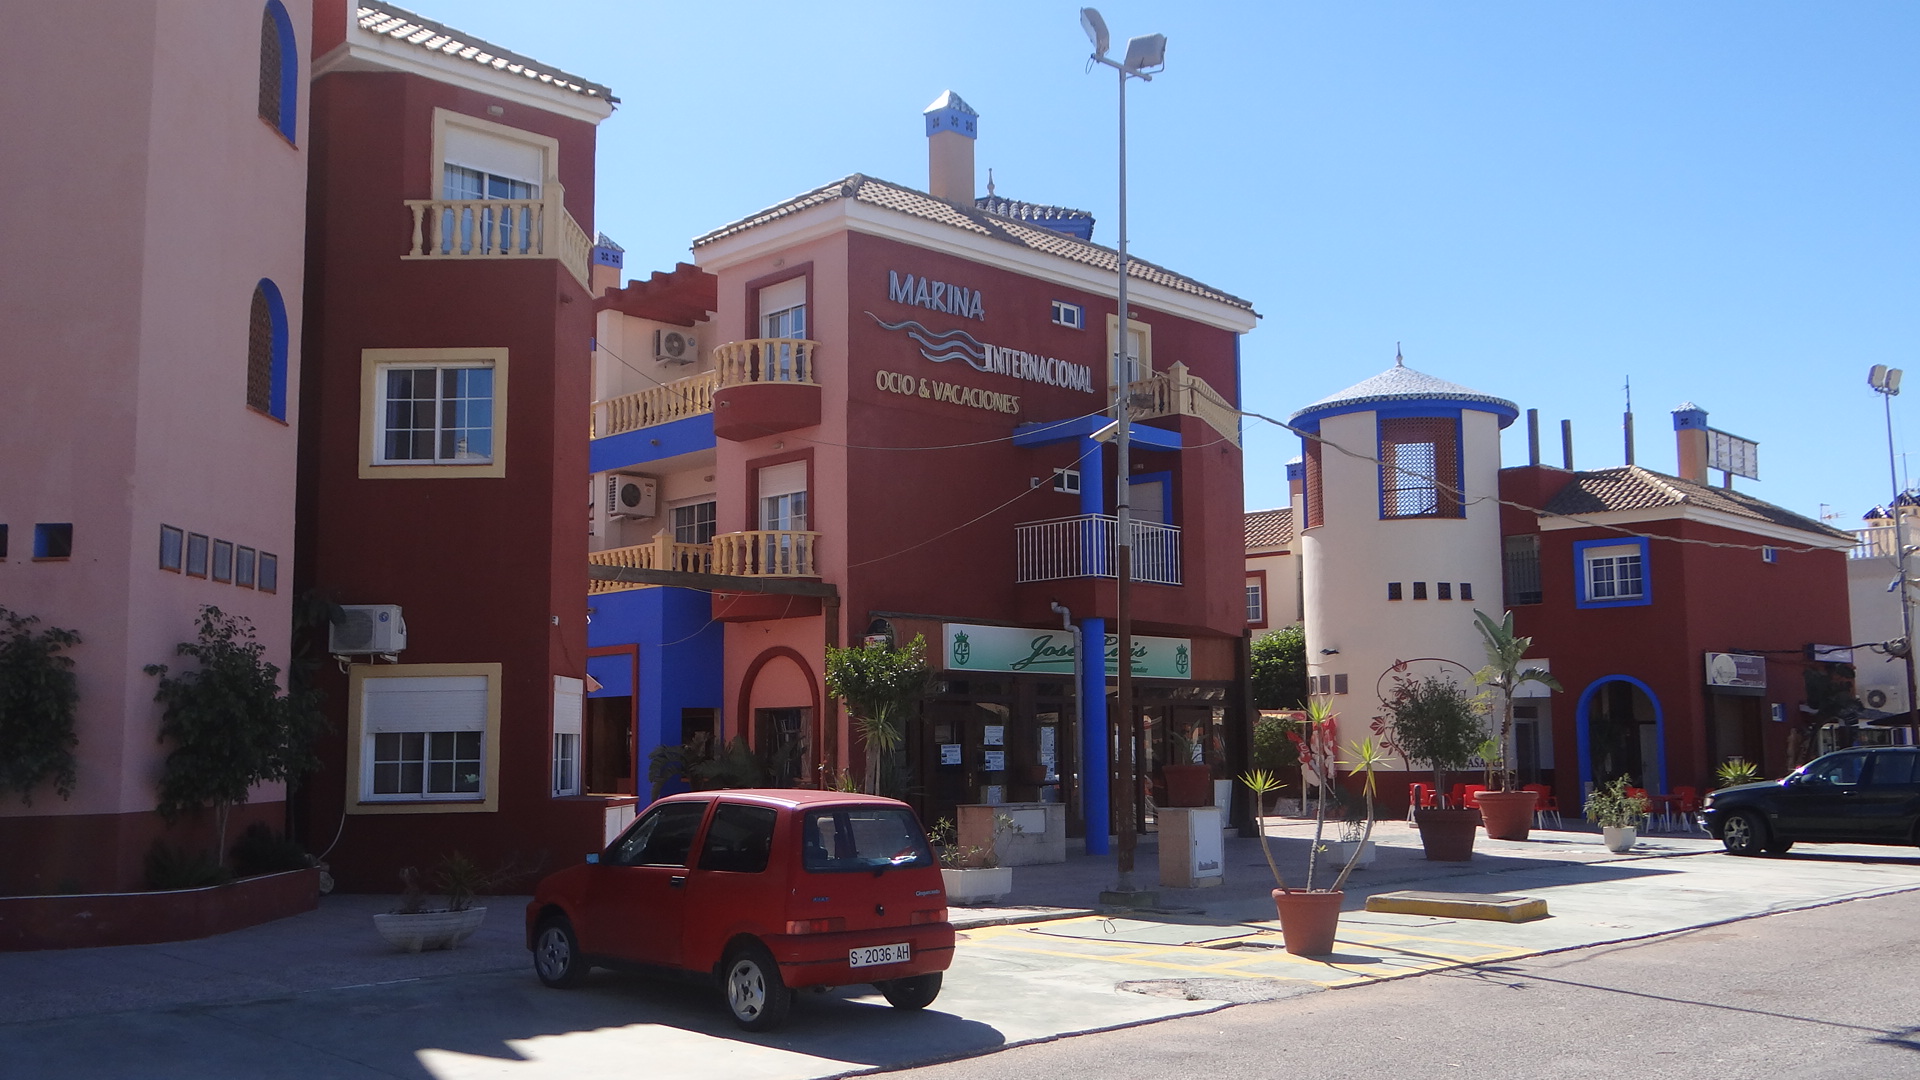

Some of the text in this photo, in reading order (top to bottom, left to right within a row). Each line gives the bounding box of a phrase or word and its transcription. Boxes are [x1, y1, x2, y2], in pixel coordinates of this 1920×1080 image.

[889, 270, 985, 321] MARINA
[876, 369, 1020, 414] OCIO & VACACIONES
[983, 343, 1095, 393] INTERNACIONAL
